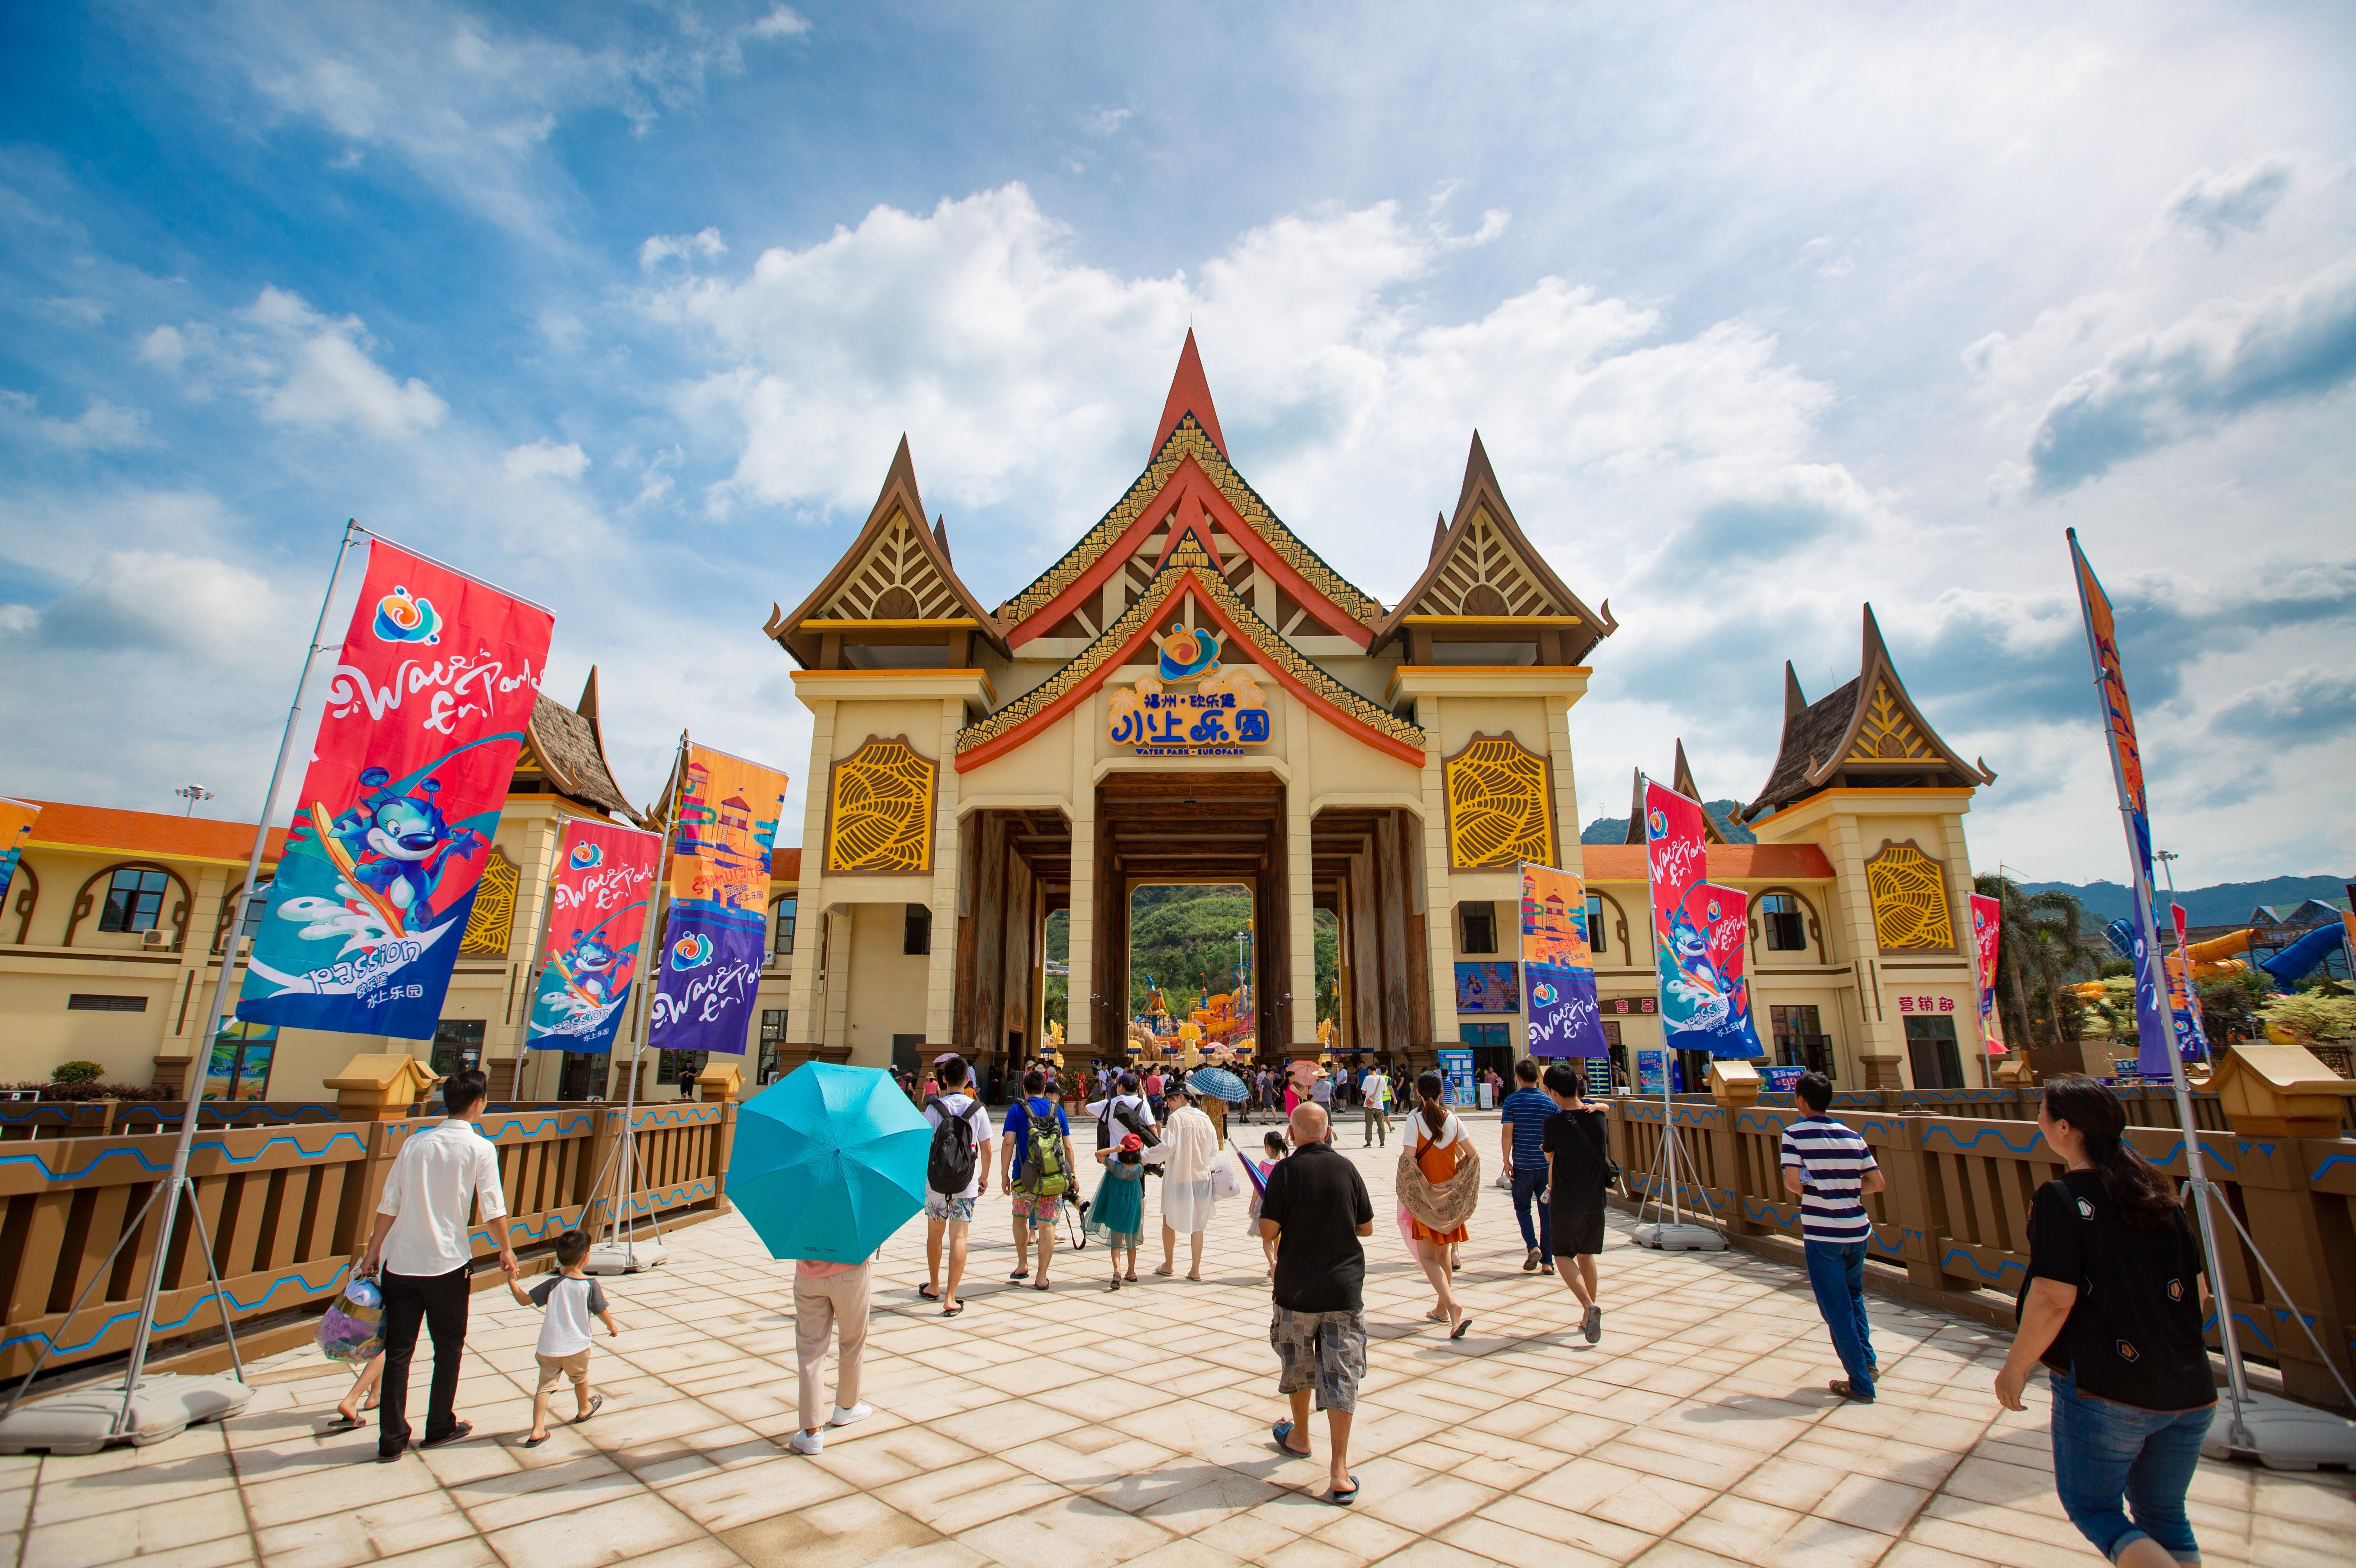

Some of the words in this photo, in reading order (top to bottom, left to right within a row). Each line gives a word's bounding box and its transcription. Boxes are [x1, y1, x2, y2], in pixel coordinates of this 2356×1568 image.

[692, 863, 764, 895] stimulate
[725, 883, 749, 896] 欧乐堡
[734, 891, 763, 903] 水上乐园
[1535, 935, 1581, 960] stimulate
[309, 941, 422, 994] passion
[357, 972, 389, 999] 欧乐堡
[367, 984, 423, 1008] 水上乐园
[1615, 999, 1654, 1013] 售票
[1898, 996, 1955, 1012] 营销部
[552, 1009, 611, 1034] passion
[1685, 998, 1730, 1031] passion
[1705, 1016, 1727, 1032] 欧乐堡
[574, 1024, 596, 1037] 欧乐堡
[583, 1028, 609, 1042] 水上乐园
